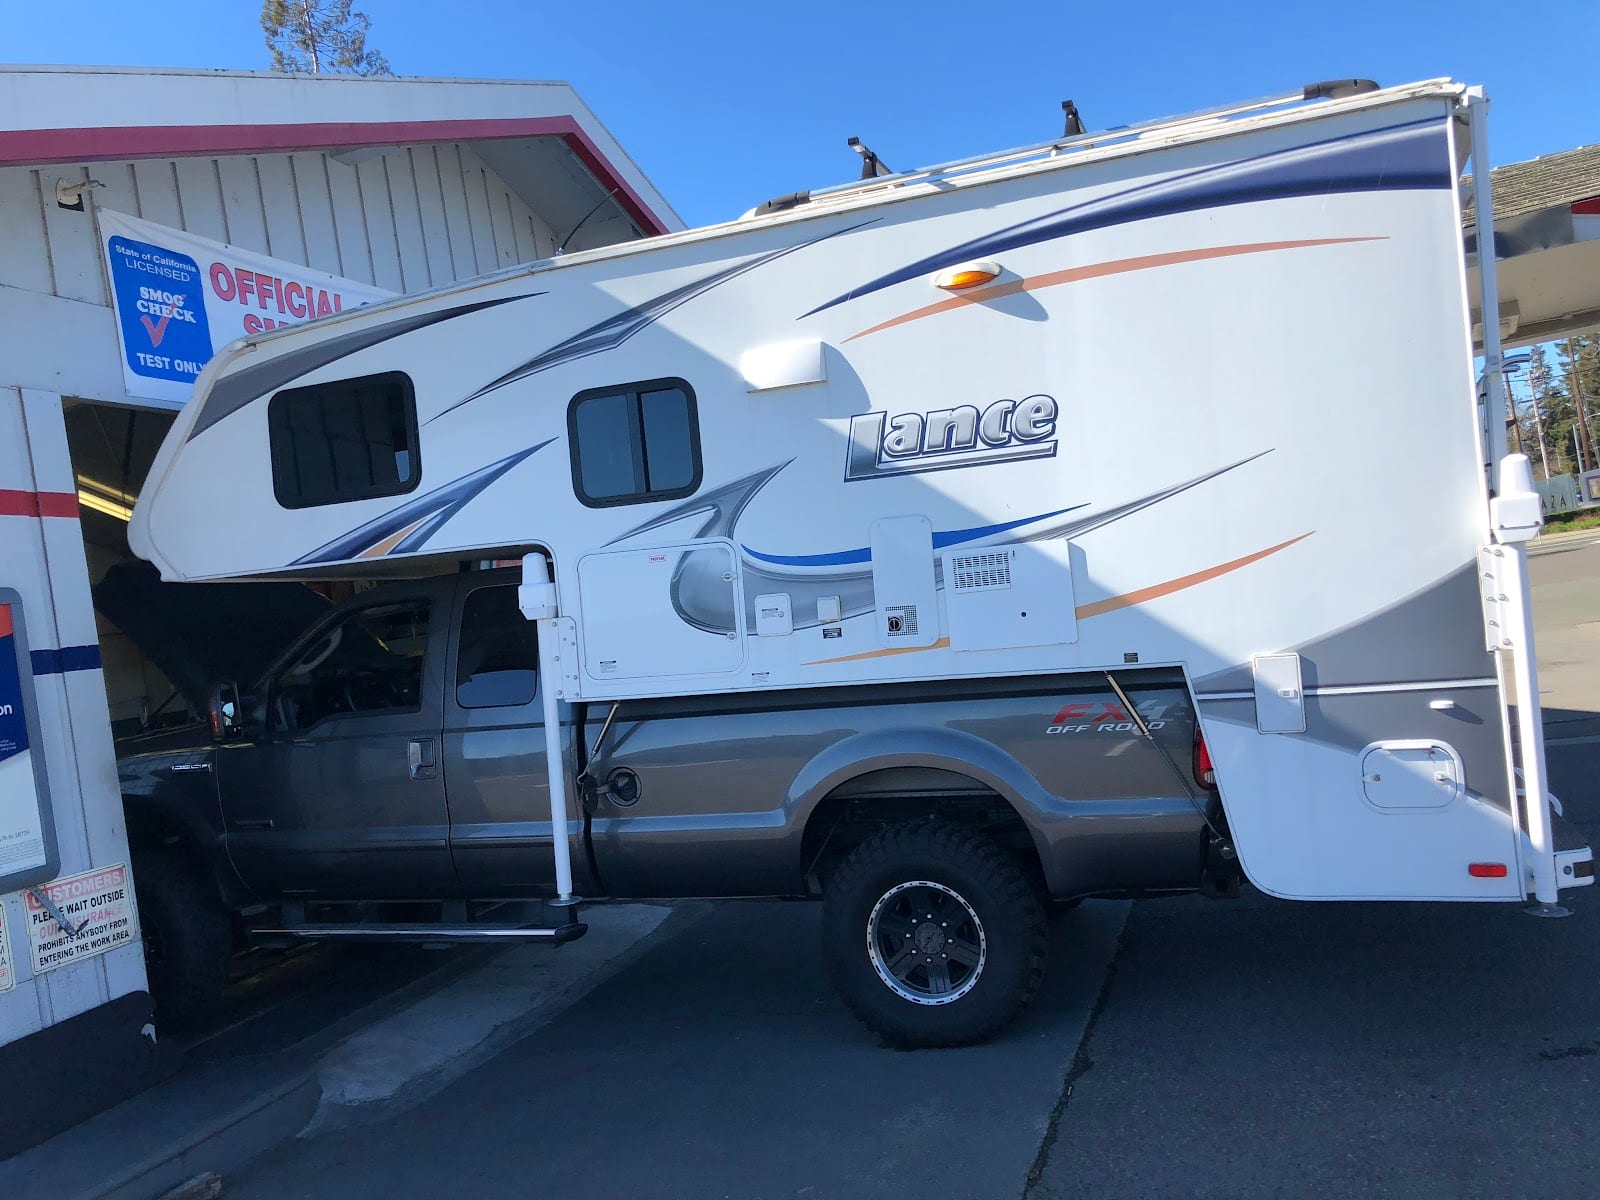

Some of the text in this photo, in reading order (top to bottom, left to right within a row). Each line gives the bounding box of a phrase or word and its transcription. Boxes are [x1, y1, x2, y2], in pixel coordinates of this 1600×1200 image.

[115, 244, 197, 273] State of California
[125, 258, 190, 282] LICENSED
[139, 286, 185, 307] SMOG
[136, 299, 197, 324] CHECK
[136, 352, 170, 370] TEST
[1052, 699, 1168, 725] FX4
[1046, 724, 1091, 734] OFF
[31, 871, 120, 907] CSTOMERS
[33, 889, 125, 925] PLEE WAIT OUTSIDE
[66, 903, 124, 927] NSURANCE
[38, 917, 128, 953] PROHIBITS ANYBODY FROM
[39, 929, 130, 966] ENTERING THE WORK AREA
